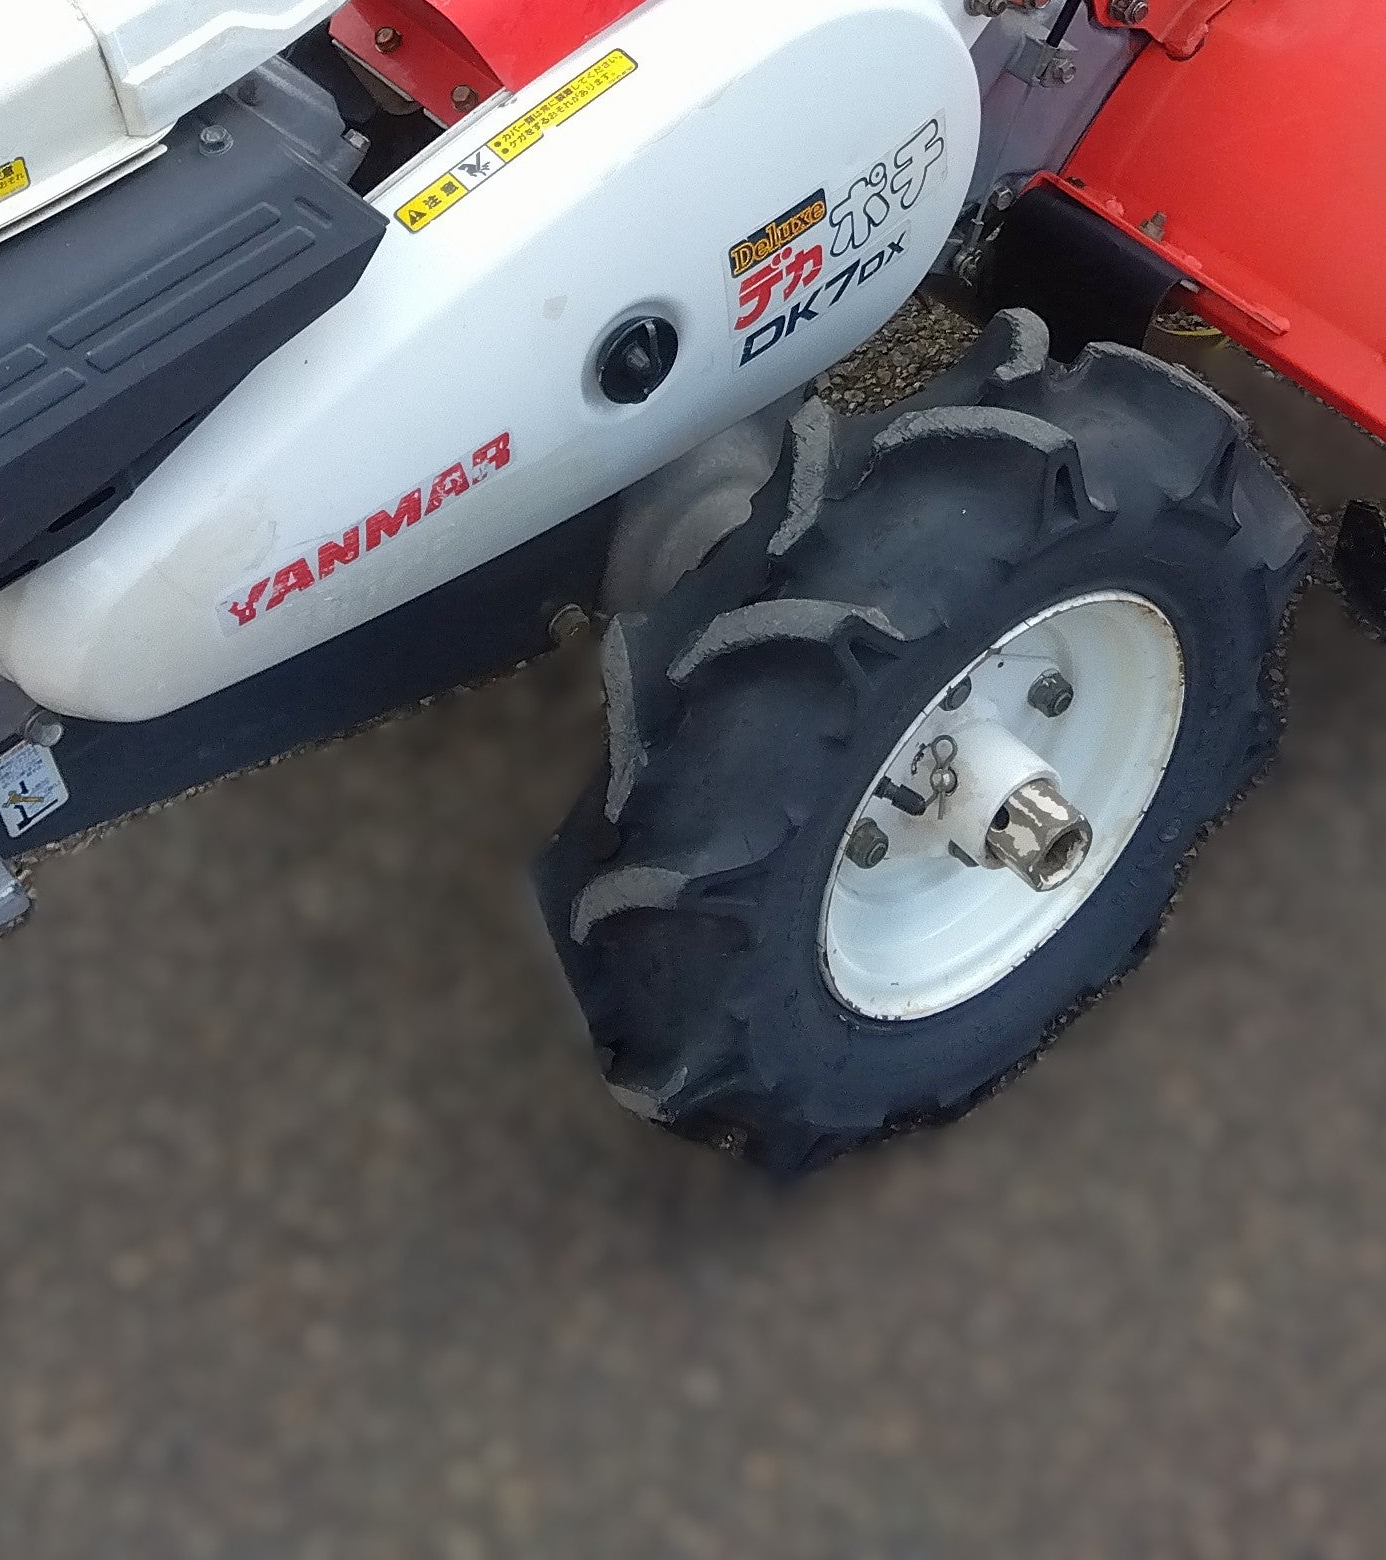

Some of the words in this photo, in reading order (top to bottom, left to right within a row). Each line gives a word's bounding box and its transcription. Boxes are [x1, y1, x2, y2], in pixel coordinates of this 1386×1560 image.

[422, 180, 459, 210] 注意
[730, 198, 826, 276] Deluxe
[227, 431, 511, 627] YANMAR
